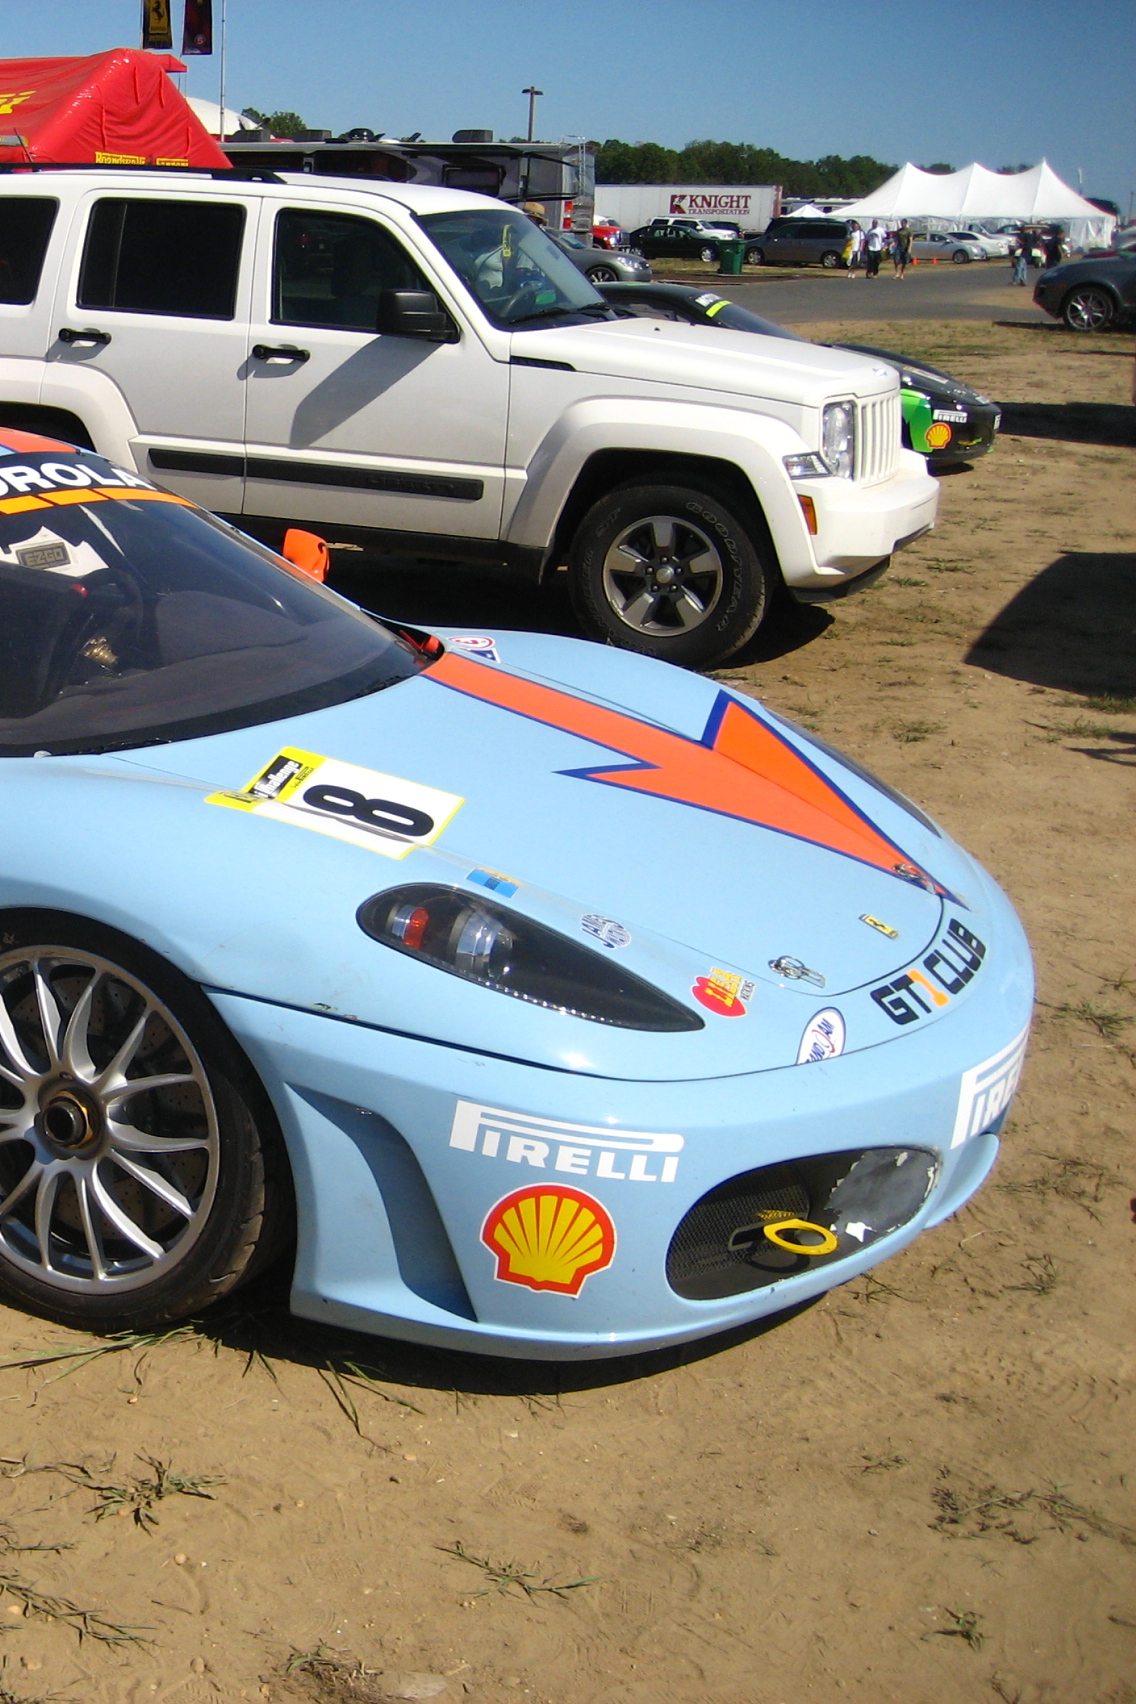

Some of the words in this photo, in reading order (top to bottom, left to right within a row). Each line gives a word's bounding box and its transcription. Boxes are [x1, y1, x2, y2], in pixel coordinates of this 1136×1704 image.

[689, 195, 752, 208] KNIGHT
[932, 409, 968, 423] PIRELLI
[253, 760, 301, 795] Challenge
[923, 918, 986, 995] CLUB
[449, 1100, 685, 1183] PIRELLI
